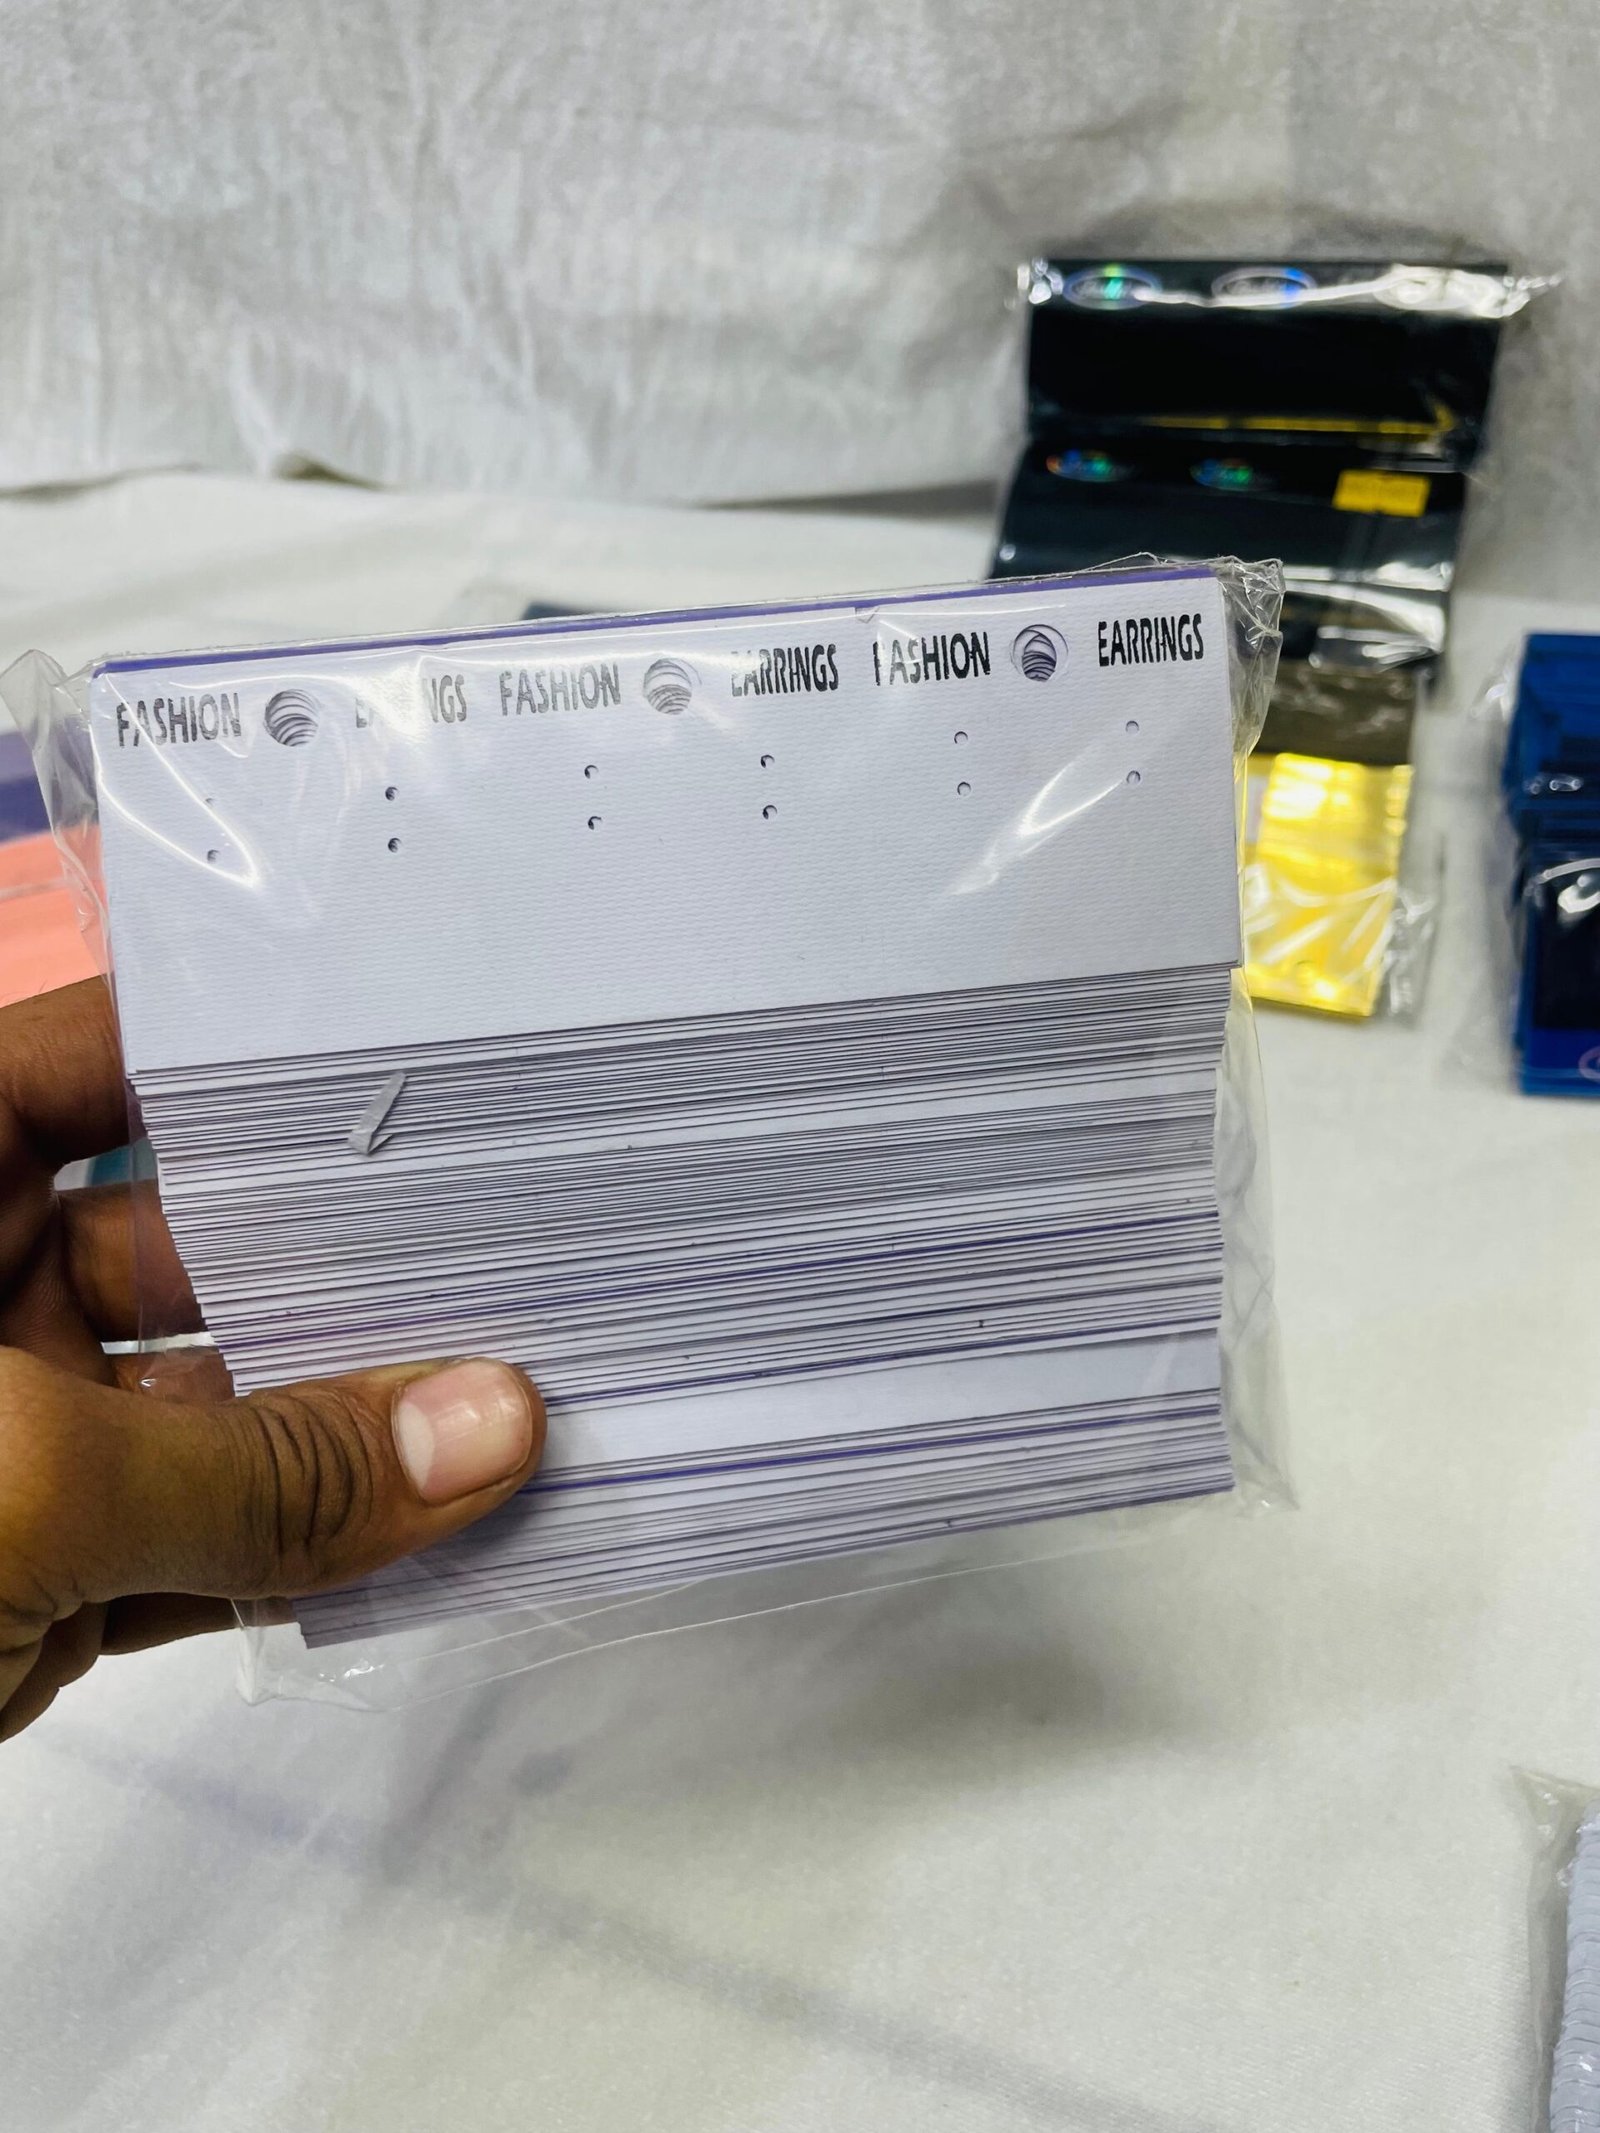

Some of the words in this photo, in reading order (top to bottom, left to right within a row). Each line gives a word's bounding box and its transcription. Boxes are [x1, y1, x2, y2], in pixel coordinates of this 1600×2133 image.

[1098, 613, 1204, 667] EARRINGS
[499, 662, 621, 716] FASHION
[116, 692, 242, 747] FASHION
